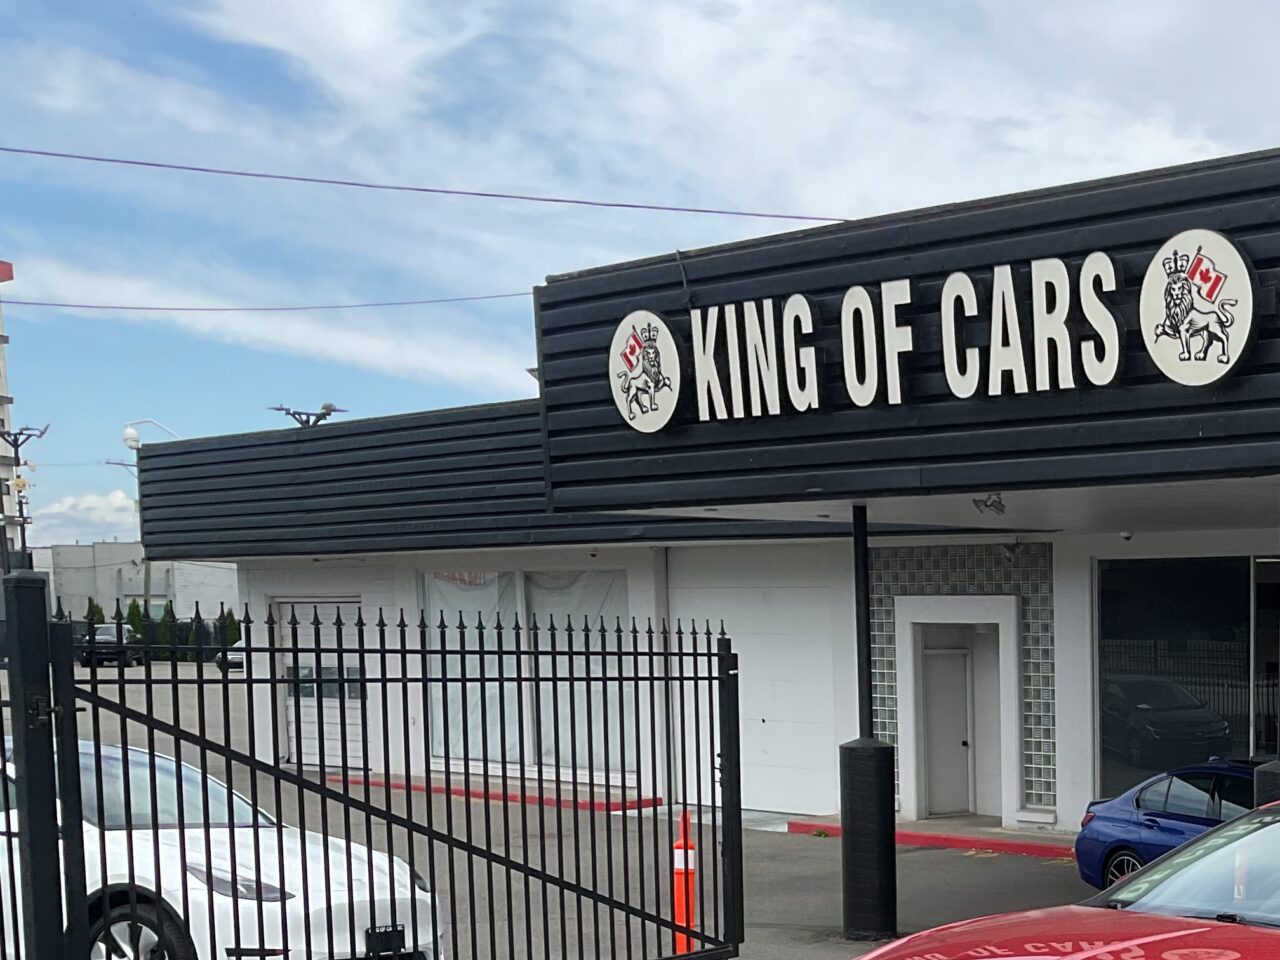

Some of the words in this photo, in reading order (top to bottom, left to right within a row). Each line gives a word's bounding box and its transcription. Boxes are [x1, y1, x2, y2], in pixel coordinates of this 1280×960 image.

[690, 293, 820, 422] KING
[841, 278, 913, 408] OF
[940, 250, 1122, 399] CARS
